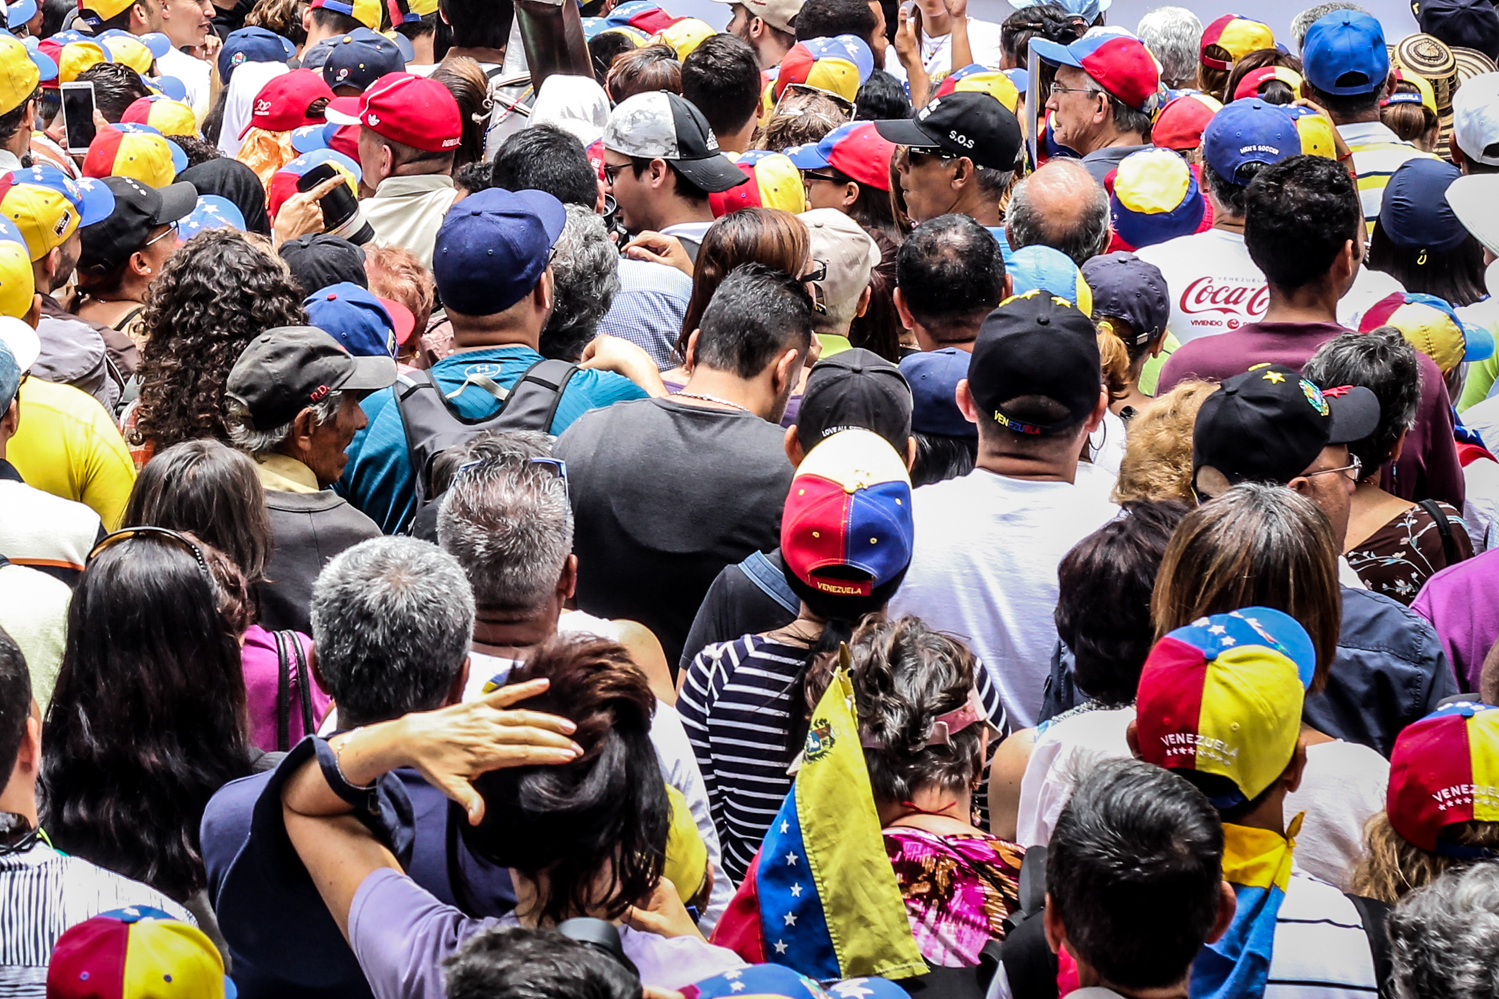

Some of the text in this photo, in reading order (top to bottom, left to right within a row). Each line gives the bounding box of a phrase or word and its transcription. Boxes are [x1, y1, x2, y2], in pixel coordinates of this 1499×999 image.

[949, 130, 975, 149] S.O.S
[1240, 145, 1280, 155] MEN'S SOCCER
[1190, 319, 1223, 327] VIVIENDO
[994, 410, 1041, 435] VENEZUELA
[817, 582, 862, 595] VENEZUELA
[1160, 733, 1238, 757] VENEZUELA
